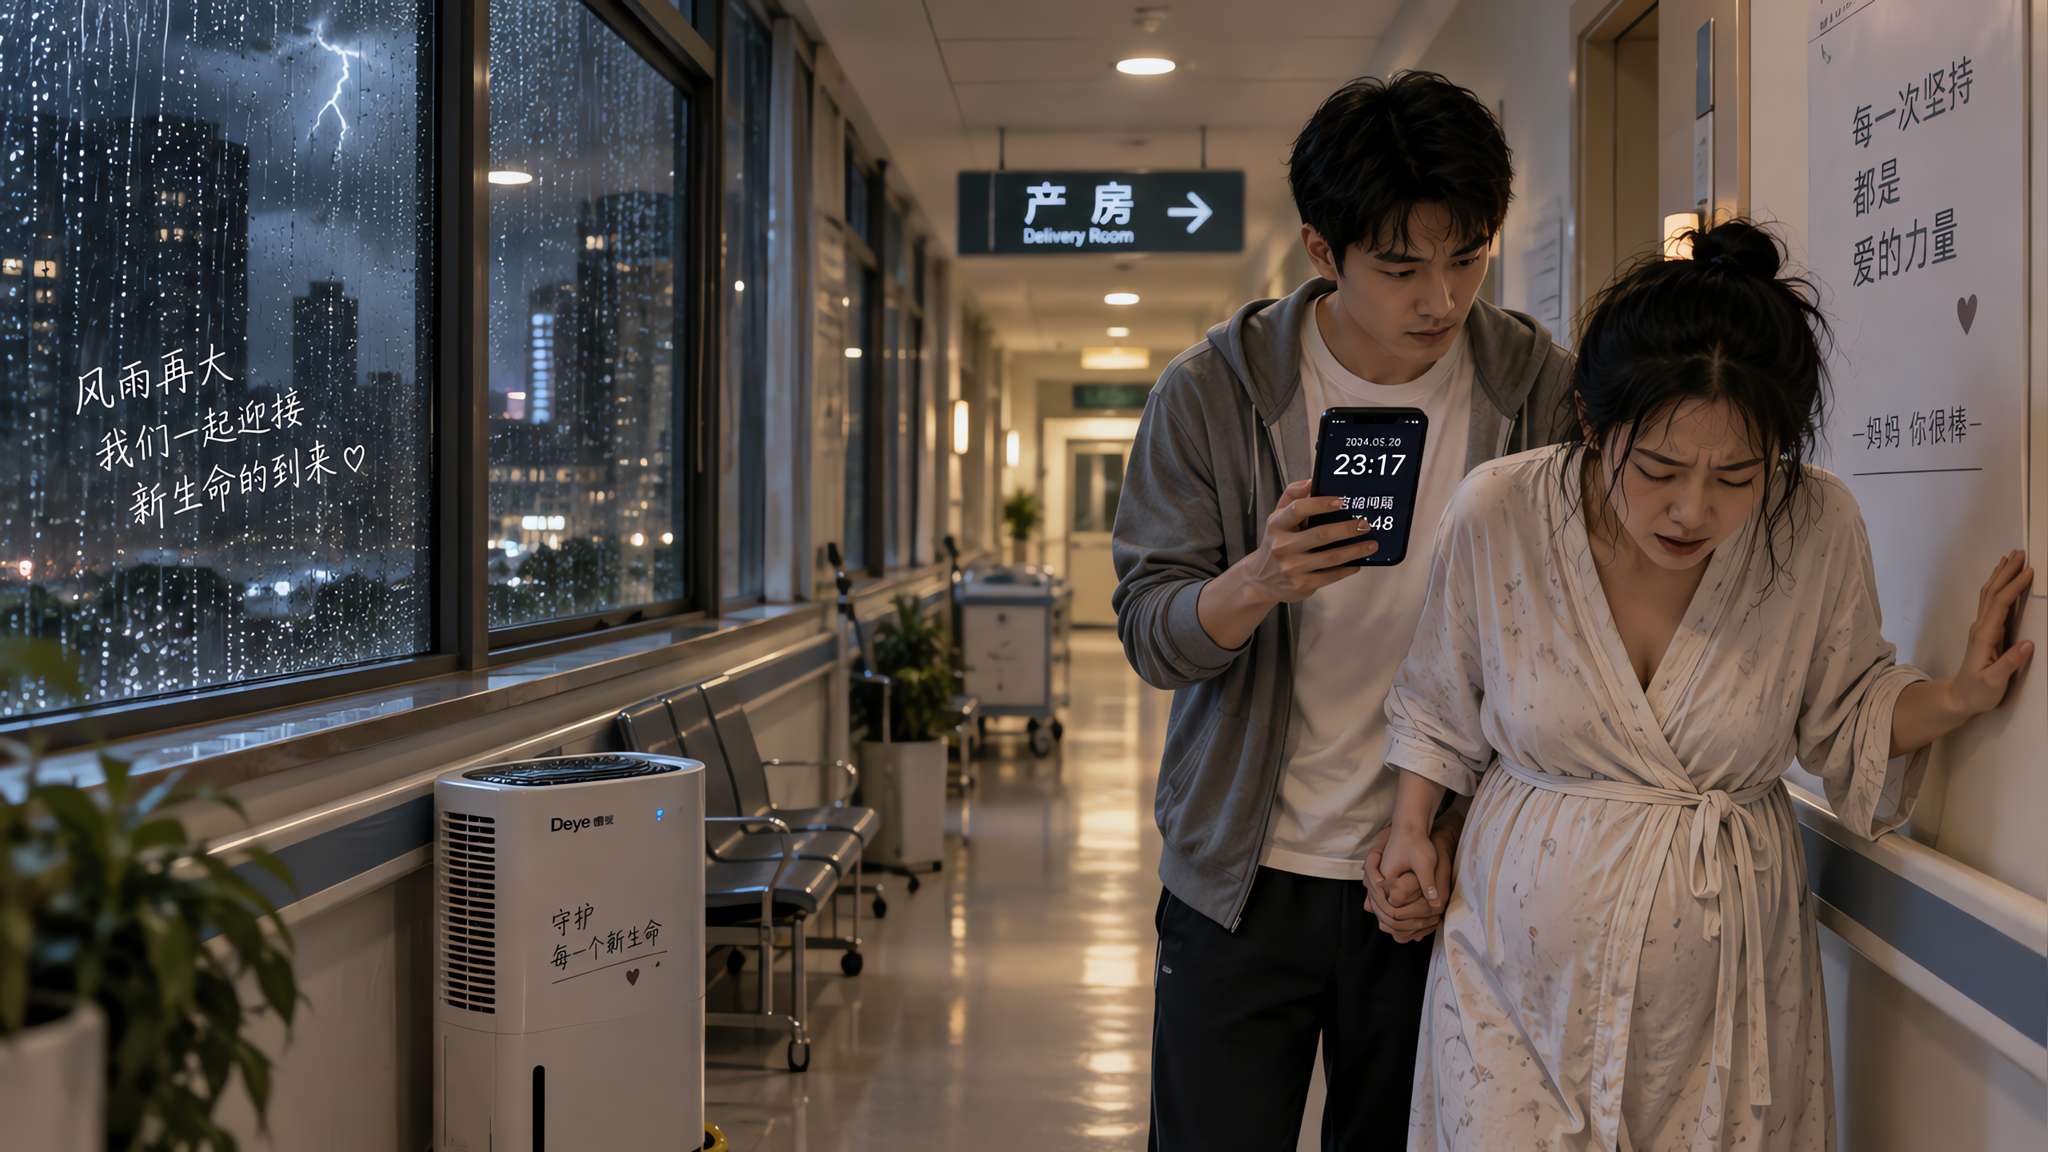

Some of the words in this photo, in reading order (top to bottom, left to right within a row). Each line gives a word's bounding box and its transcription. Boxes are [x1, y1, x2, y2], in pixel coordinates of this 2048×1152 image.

[1852, 56, 1973, 149] 每一次坚持
[1024, 181, 1134, 225] 产房
[1853, 158, 1901, 218] 都是
[1023, 227, 1086, 247] Delivery
[1089, 227, 1134, 243] Room
[1853, 207, 1957, 288] 爱的力量
[76, 343, 234, 415] 风雨再大
[96, 387, 304, 471] 我们一起迎接
[129, 440, 337, 529] 新生命的到来
[1333, 453, 1406, 476] 23:17
[551, 817, 590, 833] Deye
[550, 919, 662, 970] 每一个新生命
[552, 903, 594, 936] 守护
